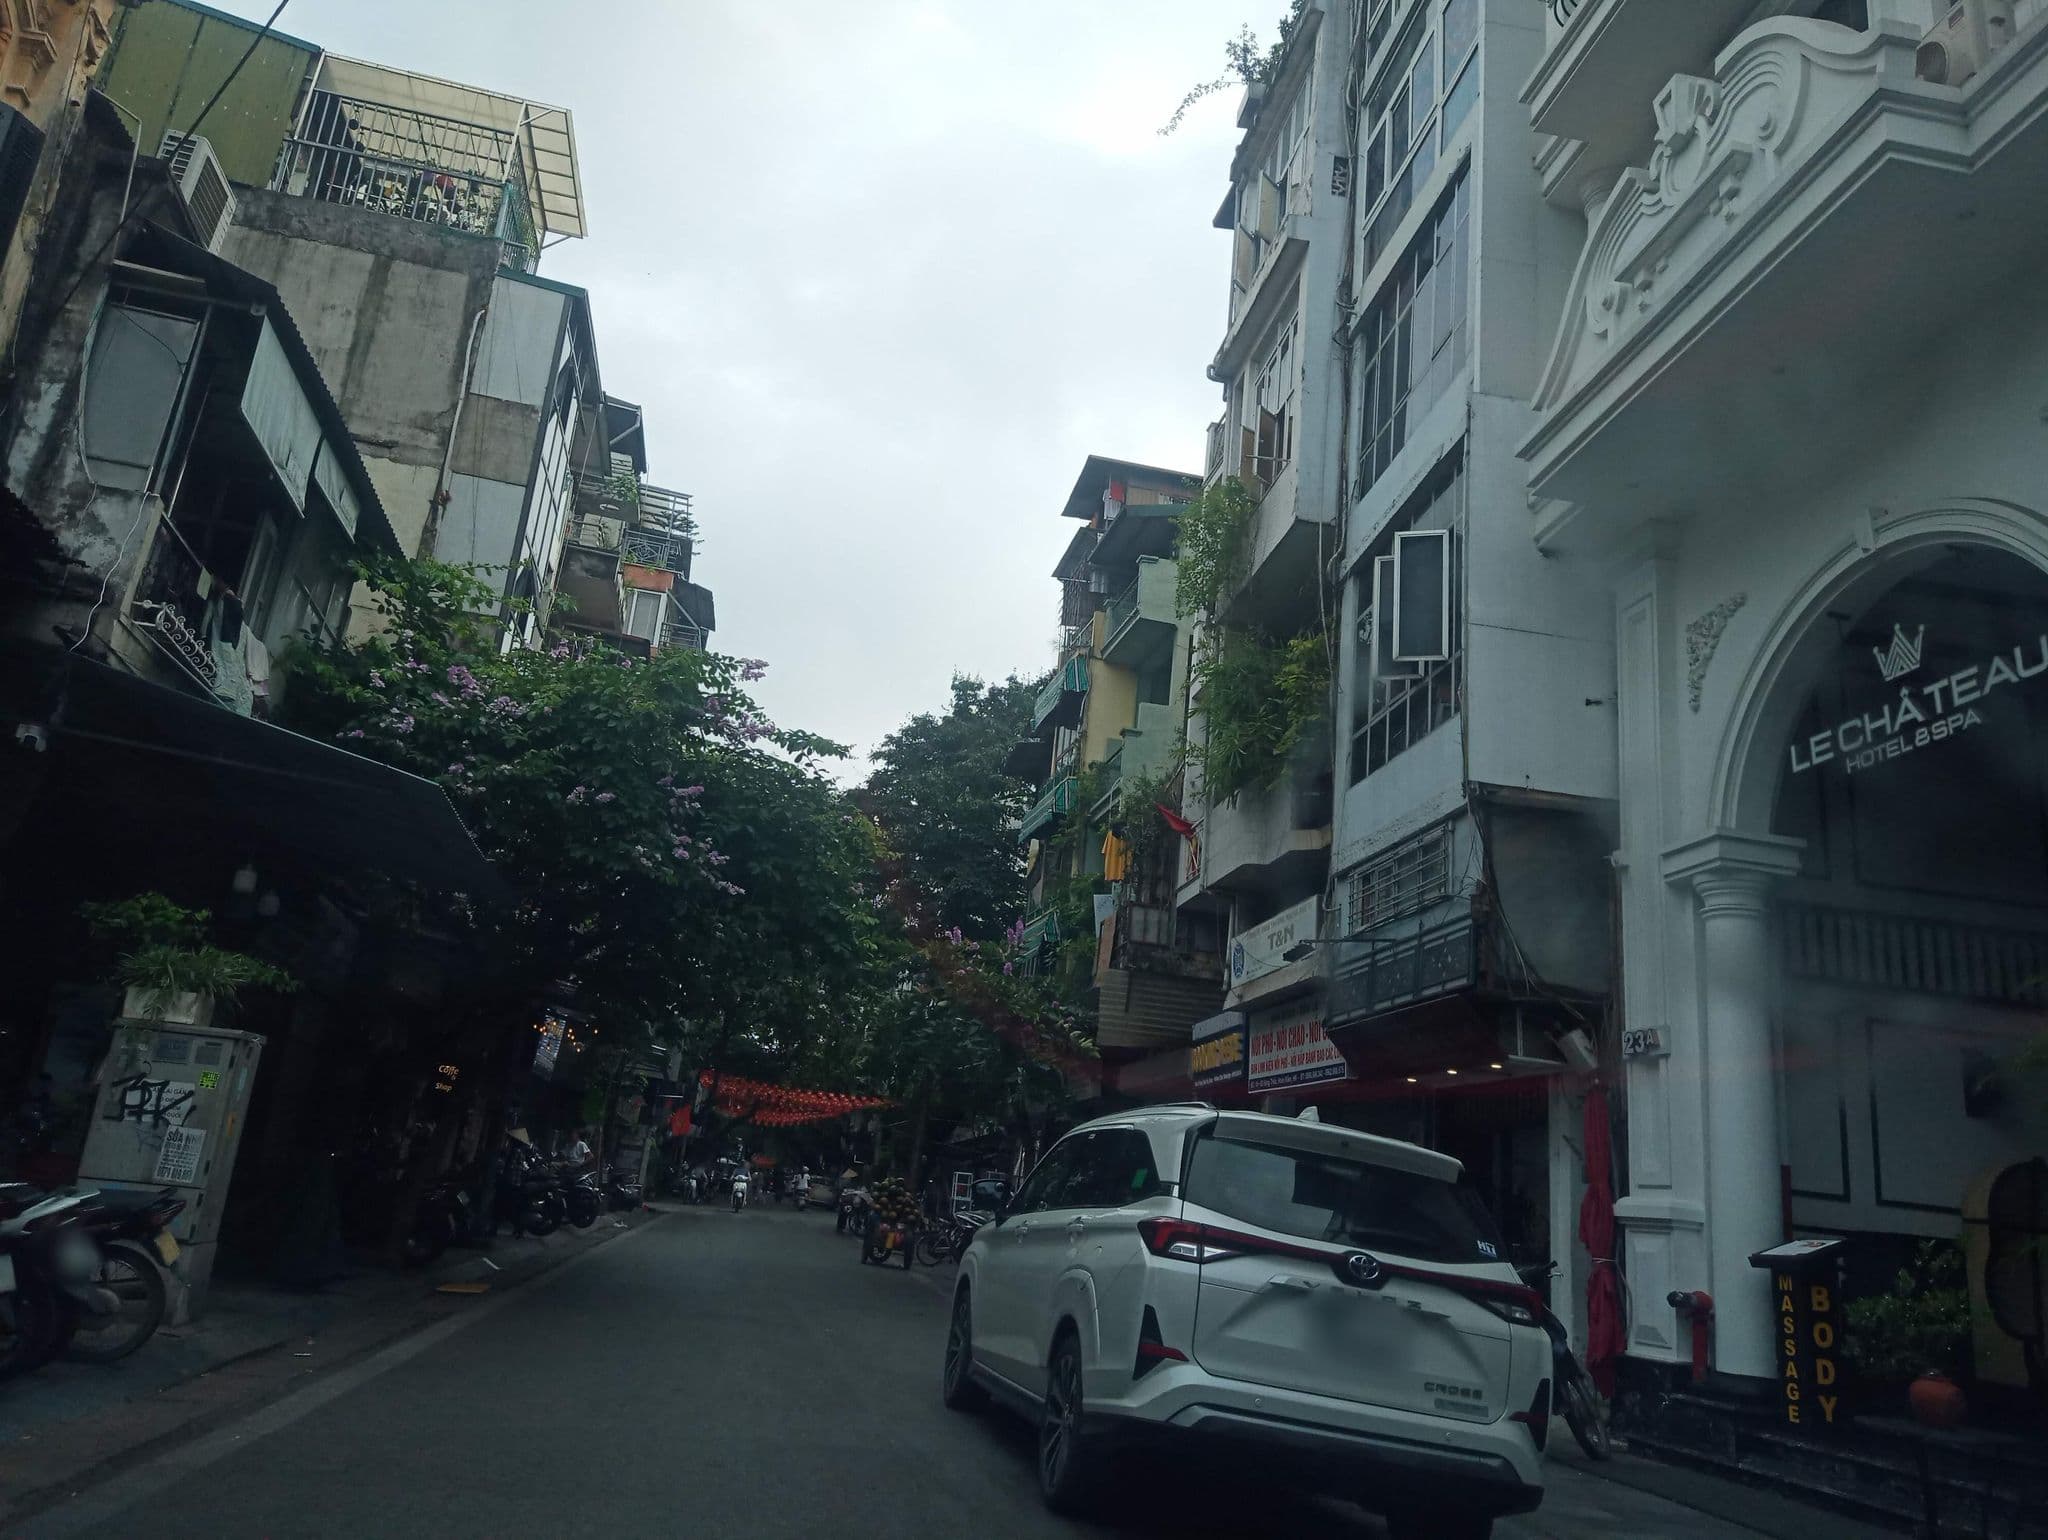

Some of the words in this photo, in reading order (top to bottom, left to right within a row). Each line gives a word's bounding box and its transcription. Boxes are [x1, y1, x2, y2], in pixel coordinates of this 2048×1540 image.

[1267, 923, 1295, 950] T&N
[1778, 1274, 1800, 1425] MASSAGE
[1811, 1285, 1837, 1425] BODY
